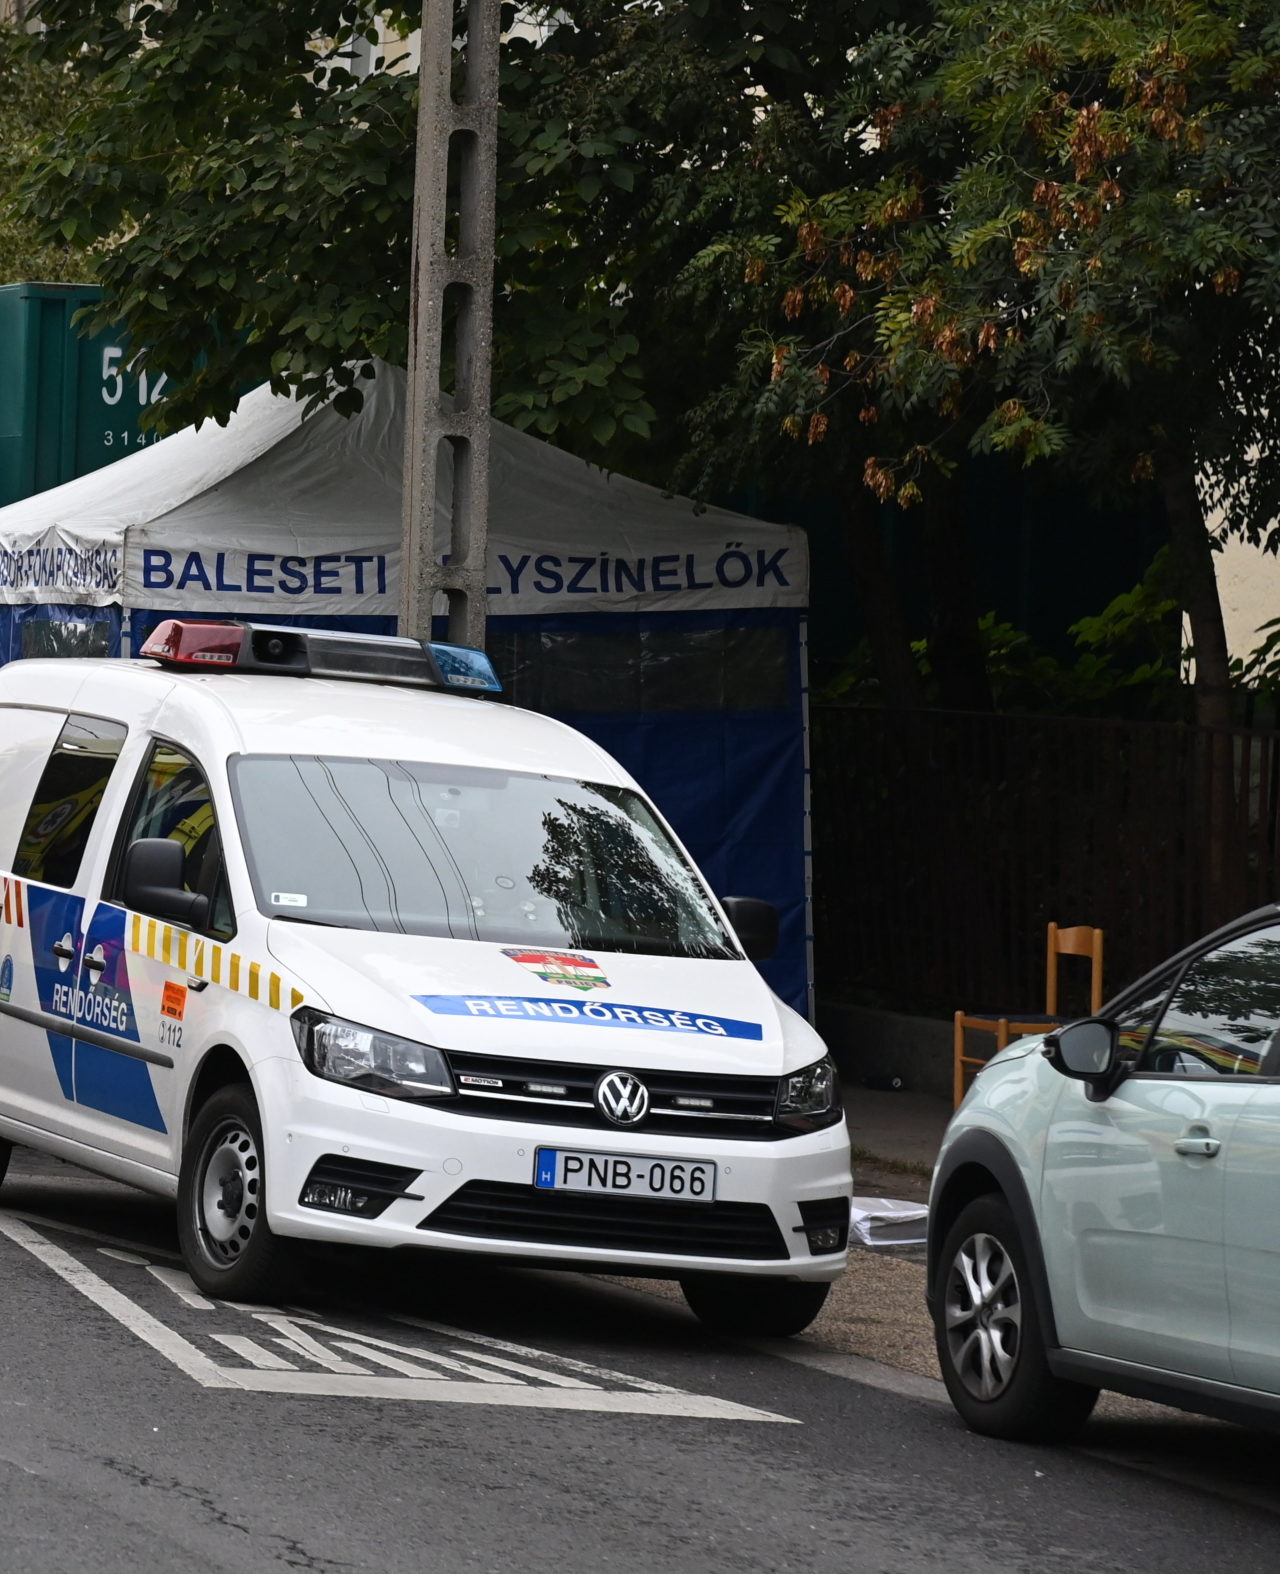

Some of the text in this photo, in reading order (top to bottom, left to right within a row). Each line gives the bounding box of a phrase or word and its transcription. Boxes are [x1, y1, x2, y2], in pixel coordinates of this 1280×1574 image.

[143, 542, 791, 595] BALESETI YSZÍNELŐK
[52, 983, 127, 1032] RENDŐRSÉG
[466, 1000, 728, 1036] RENDŐRSÉG
[167, 1023, 183, 1048] 112
[542, 1171, 551, 1183] H
[563, 1155, 706, 1196] PNB-066
